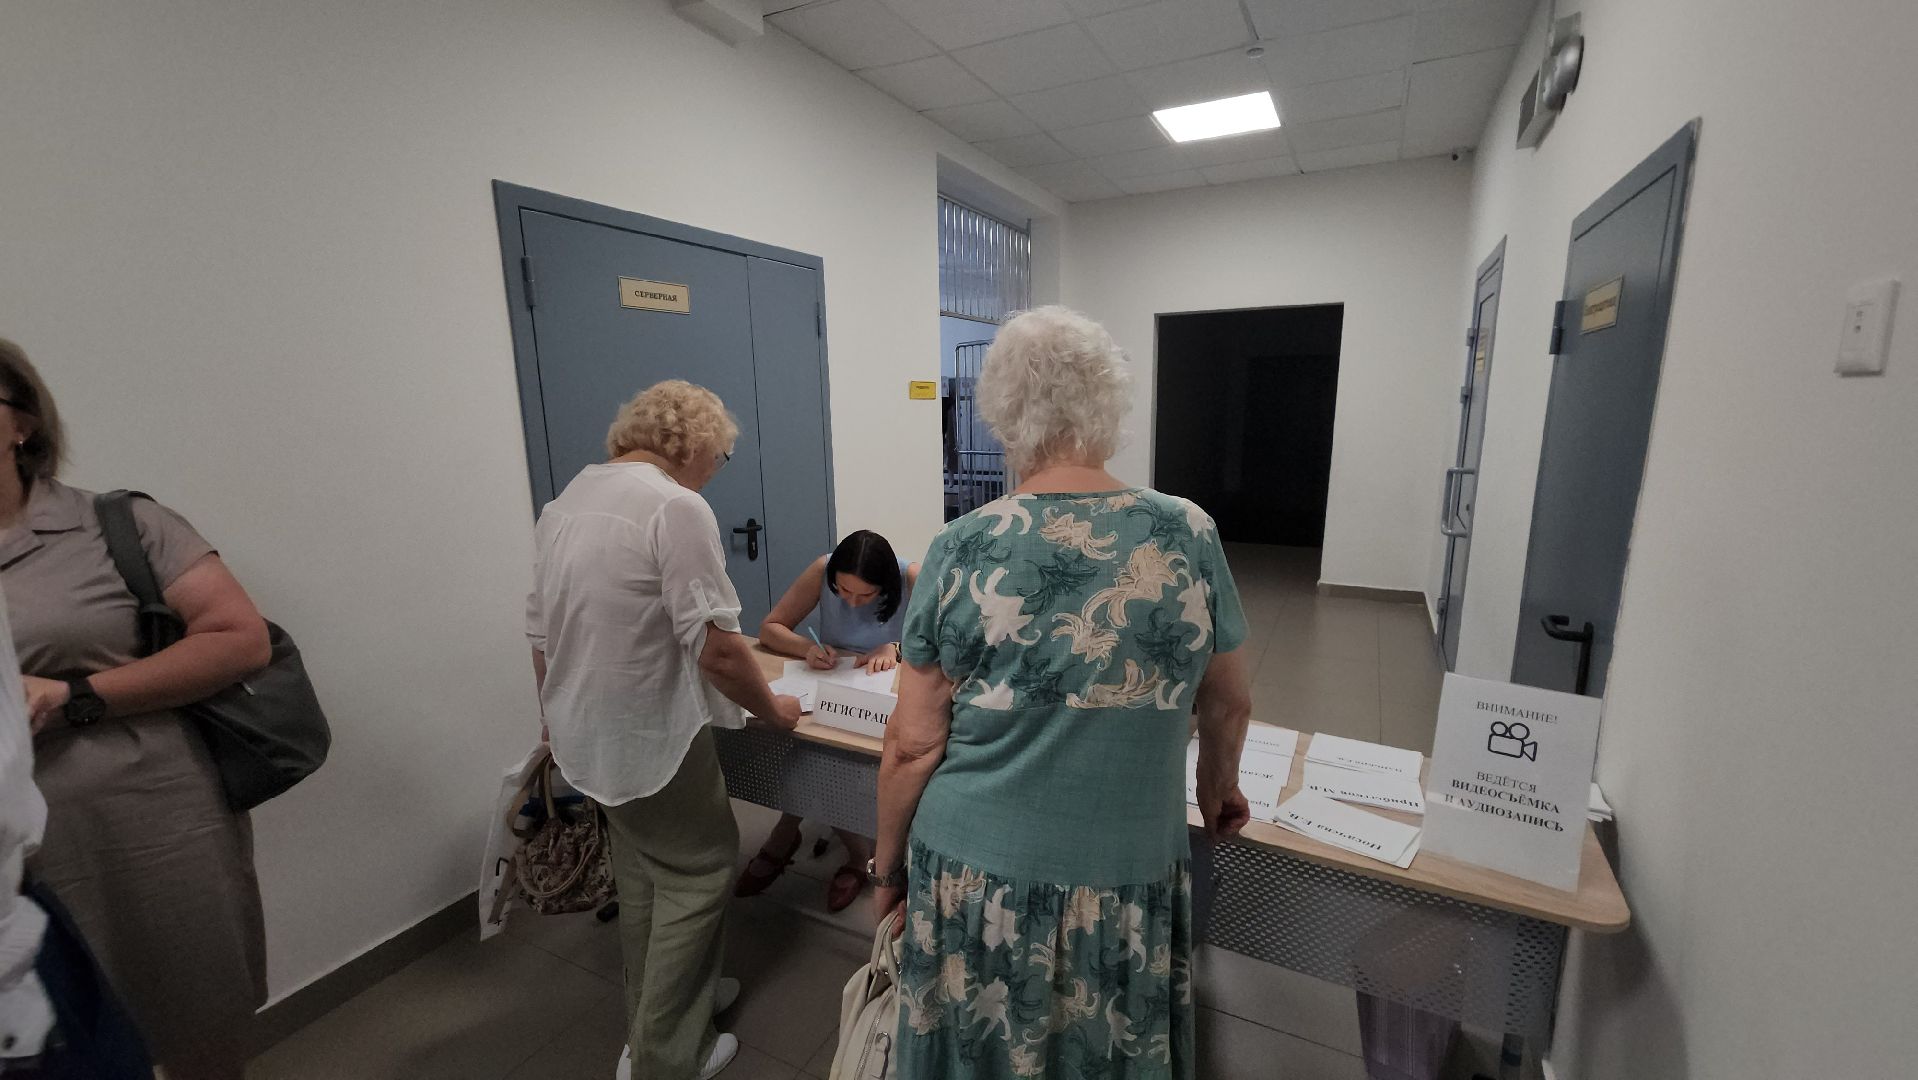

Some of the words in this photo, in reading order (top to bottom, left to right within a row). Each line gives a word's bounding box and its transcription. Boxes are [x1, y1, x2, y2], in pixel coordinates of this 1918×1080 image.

[635, 290, 678, 302] СЕРВЕРНАЯ
[820, 701, 889, 724] РЕГИСТРАЦ
[1476, 701, 1559, 725] ВНИМАНИЕ!
[1476, 771, 1537, 793] ВЕДЁТСЯ
[1452, 779, 1560, 814] ВИДЕОСЪЁМКА
[1460, 797, 1564, 832] АУДИОЗАПИСЬ
